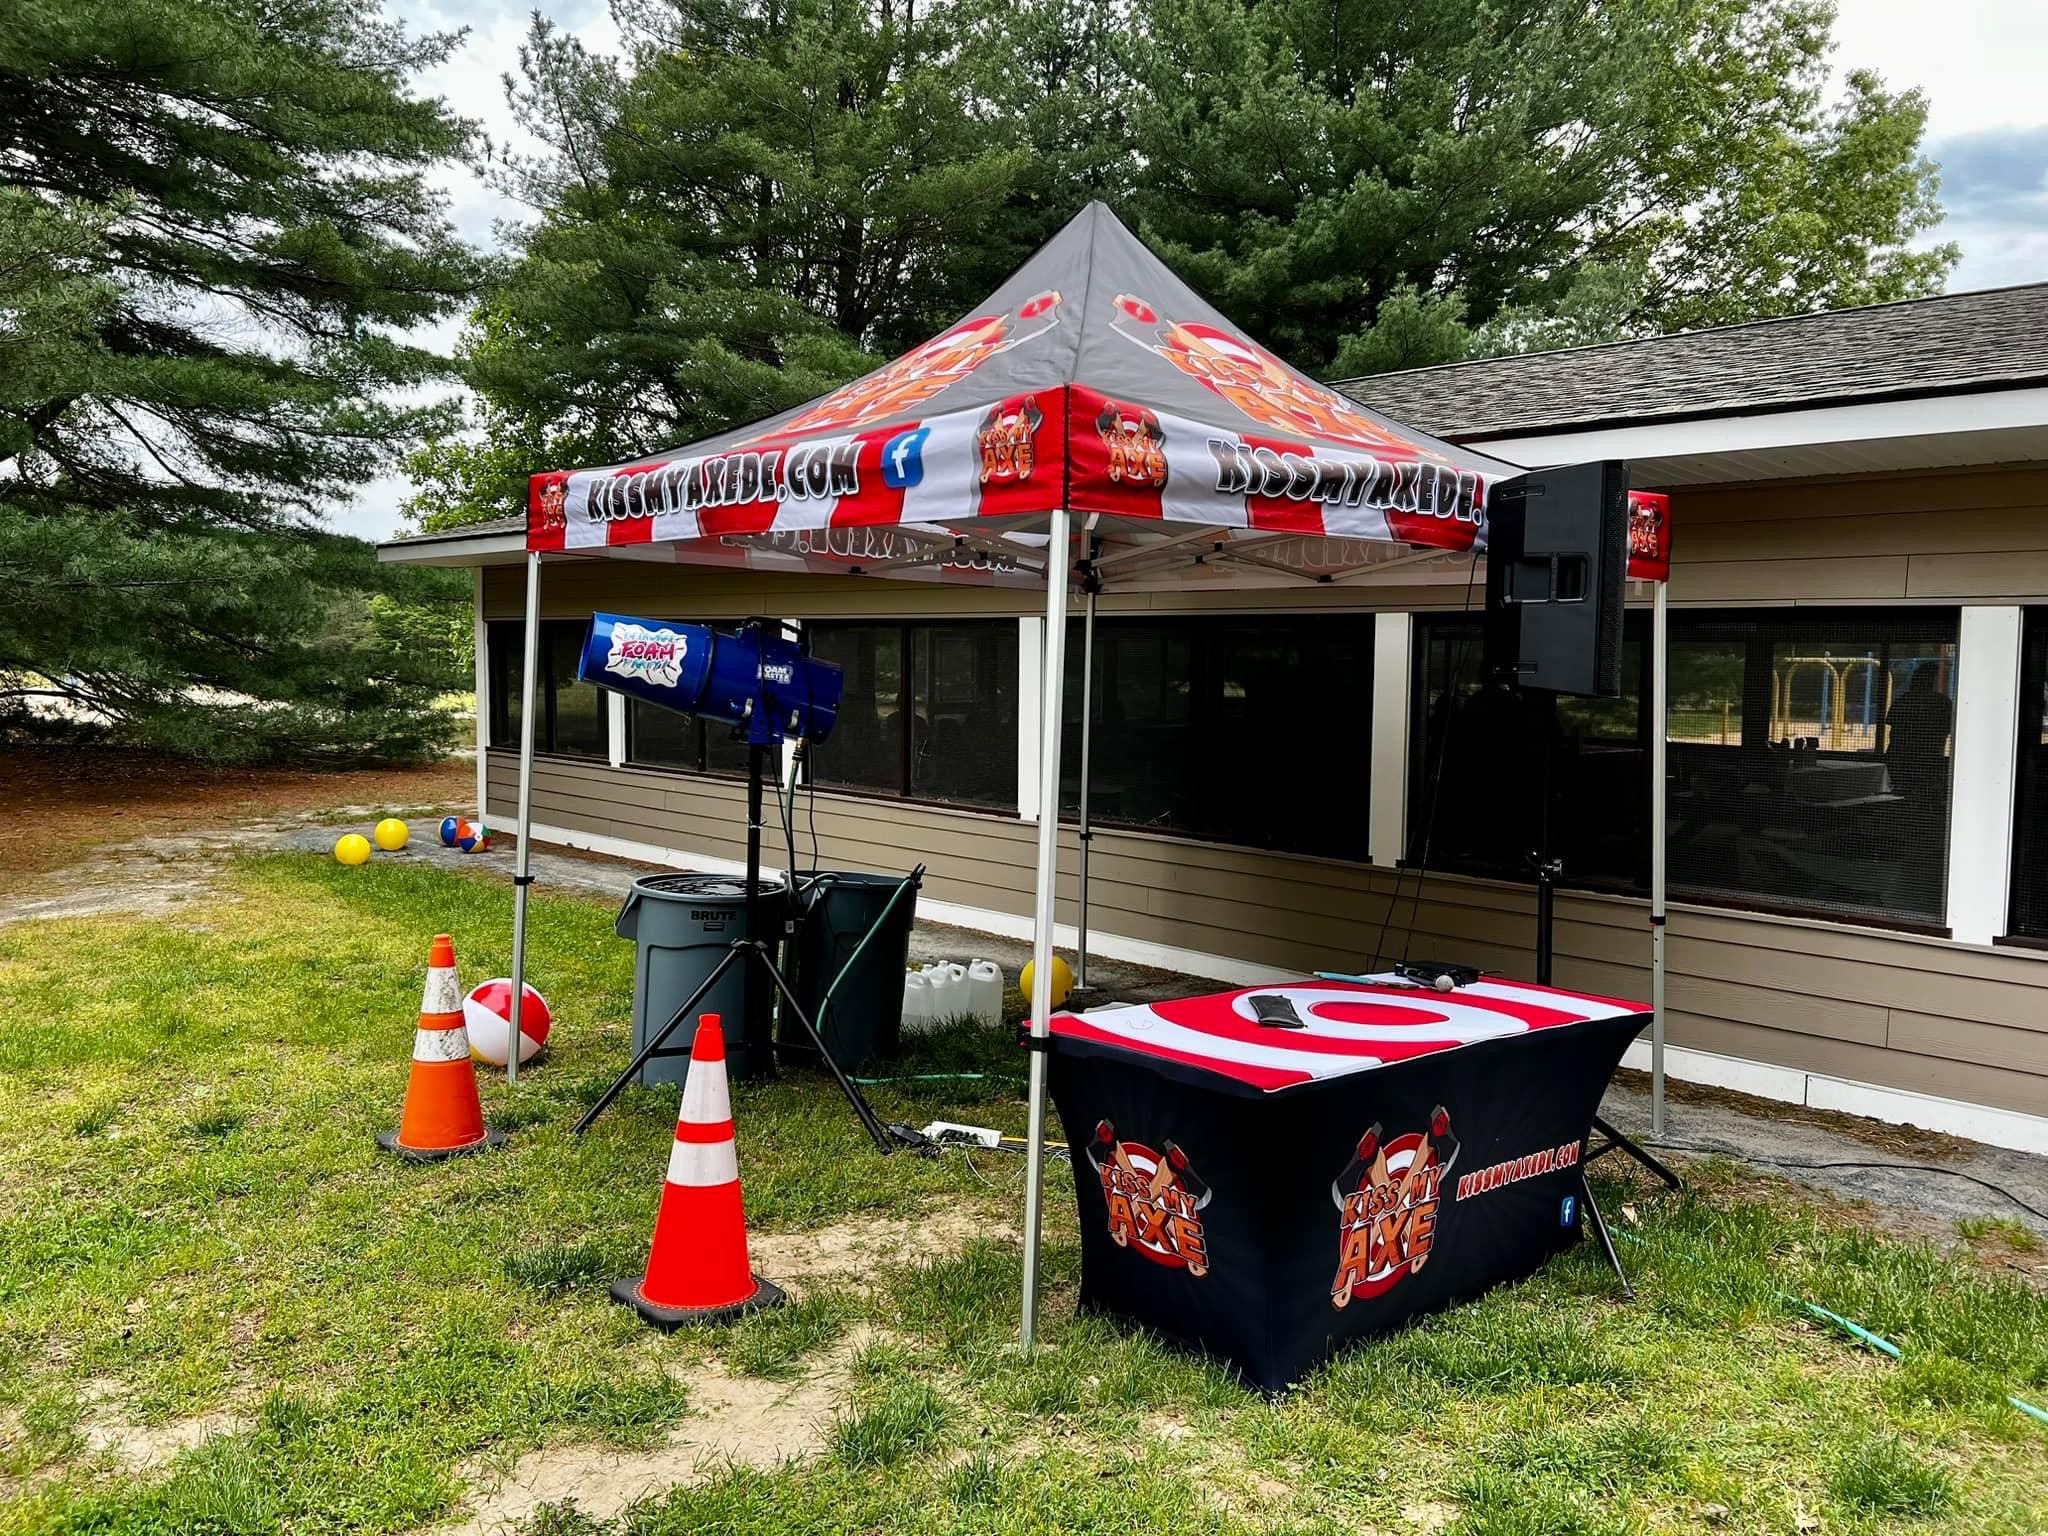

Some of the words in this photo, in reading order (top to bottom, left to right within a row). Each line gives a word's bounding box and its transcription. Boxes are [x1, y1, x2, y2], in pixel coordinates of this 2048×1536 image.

[586, 441, 866, 522] KISSMYAXEDE.COM
[981, 443, 1033, 474] AXE
[1110, 447, 1167, 479] AXE
[1207, 440, 1483, 526] KISSMYAXEDE.
[622, 640, 675, 660] FOAM
[690, 910, 737, 921] BRUTE
[1099, 1163, 1152, 1200] KISS
[1161, 1185, 1199, 1219] MY
[1340, 1178, 1401, 1229] KISS
[1409, 1162, 1447, 1205] MY
[1109, 1192, 1209, 1268] AXE
[1331, 1198, 1440, 1295] AXE
